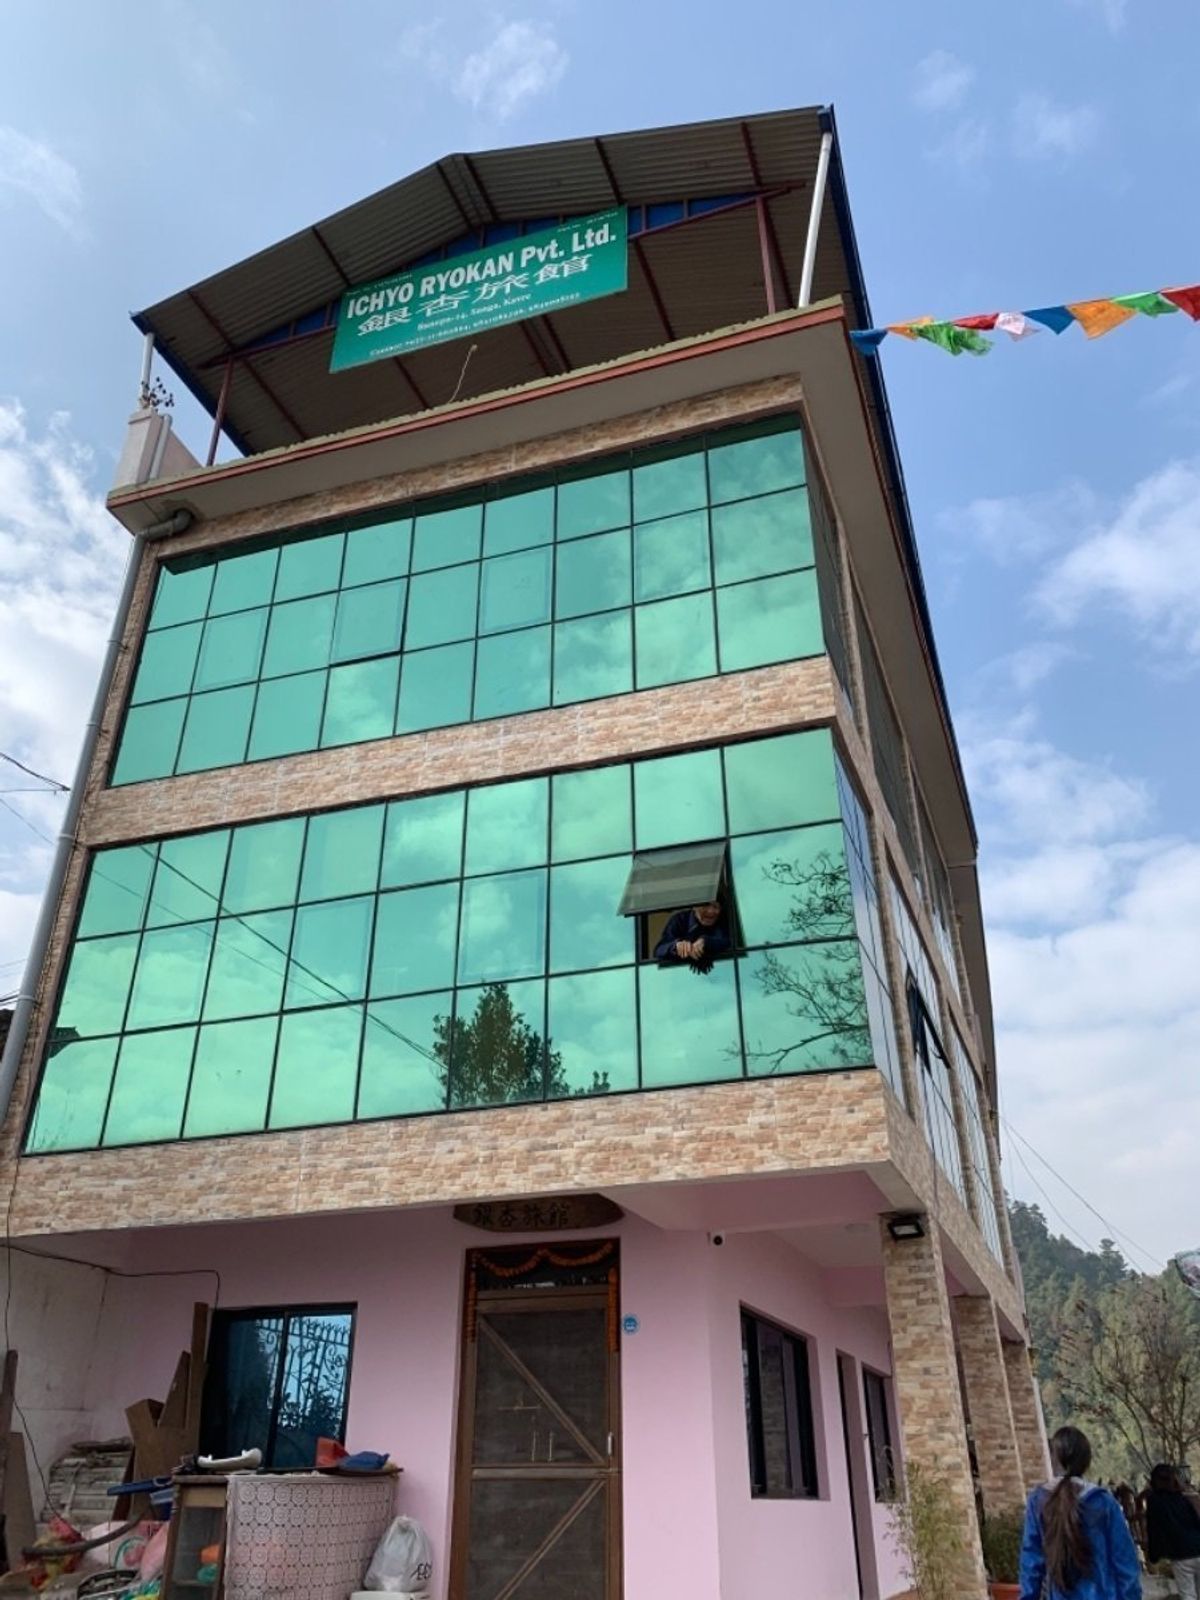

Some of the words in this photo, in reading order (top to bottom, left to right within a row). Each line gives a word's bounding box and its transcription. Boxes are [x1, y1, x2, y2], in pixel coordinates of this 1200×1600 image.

[347, 282, 414, 319] ICHYO
[420, 252, 514, 297] RYOKAN
[520, 239, 565, 268] Pvt.
[572, 222, 617, 253] Ltd.
